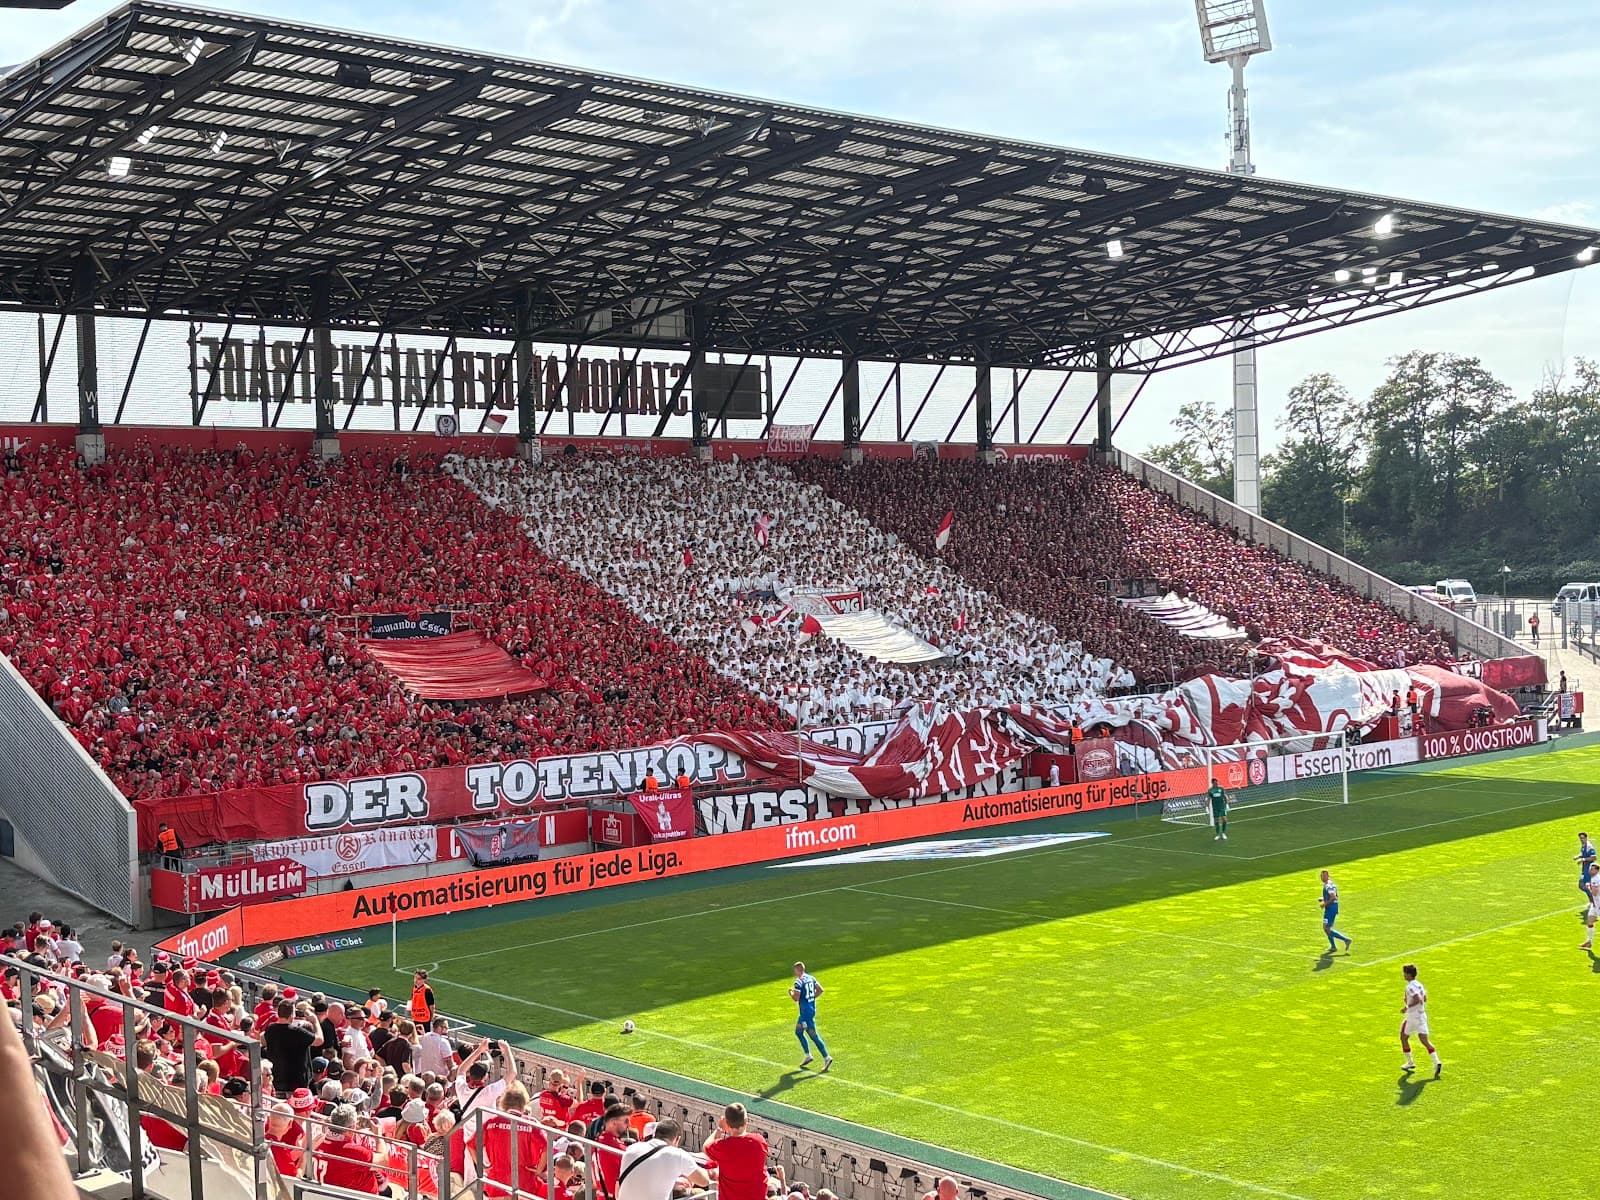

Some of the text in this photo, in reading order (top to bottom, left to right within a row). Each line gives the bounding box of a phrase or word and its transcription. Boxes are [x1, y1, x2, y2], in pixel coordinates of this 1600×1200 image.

[767, 439, 811, 453] KASTEN
[1424, 725, 1533, 758] 100 % ÖKOSTROM
[304, 773, 430, 832] DER
[963, 790, 1082, 822] Automatisierung
[1086, 785, 1106, 803] für
[1109, 779, 1136, 805] jede
[786, 824, 856, 849] ifm.com
[331, 860, 367, 874] Essen
[353, 849, 684, 919] Automatisierung für jede Liga.
[177, 925, 229, 958] ifm.com
